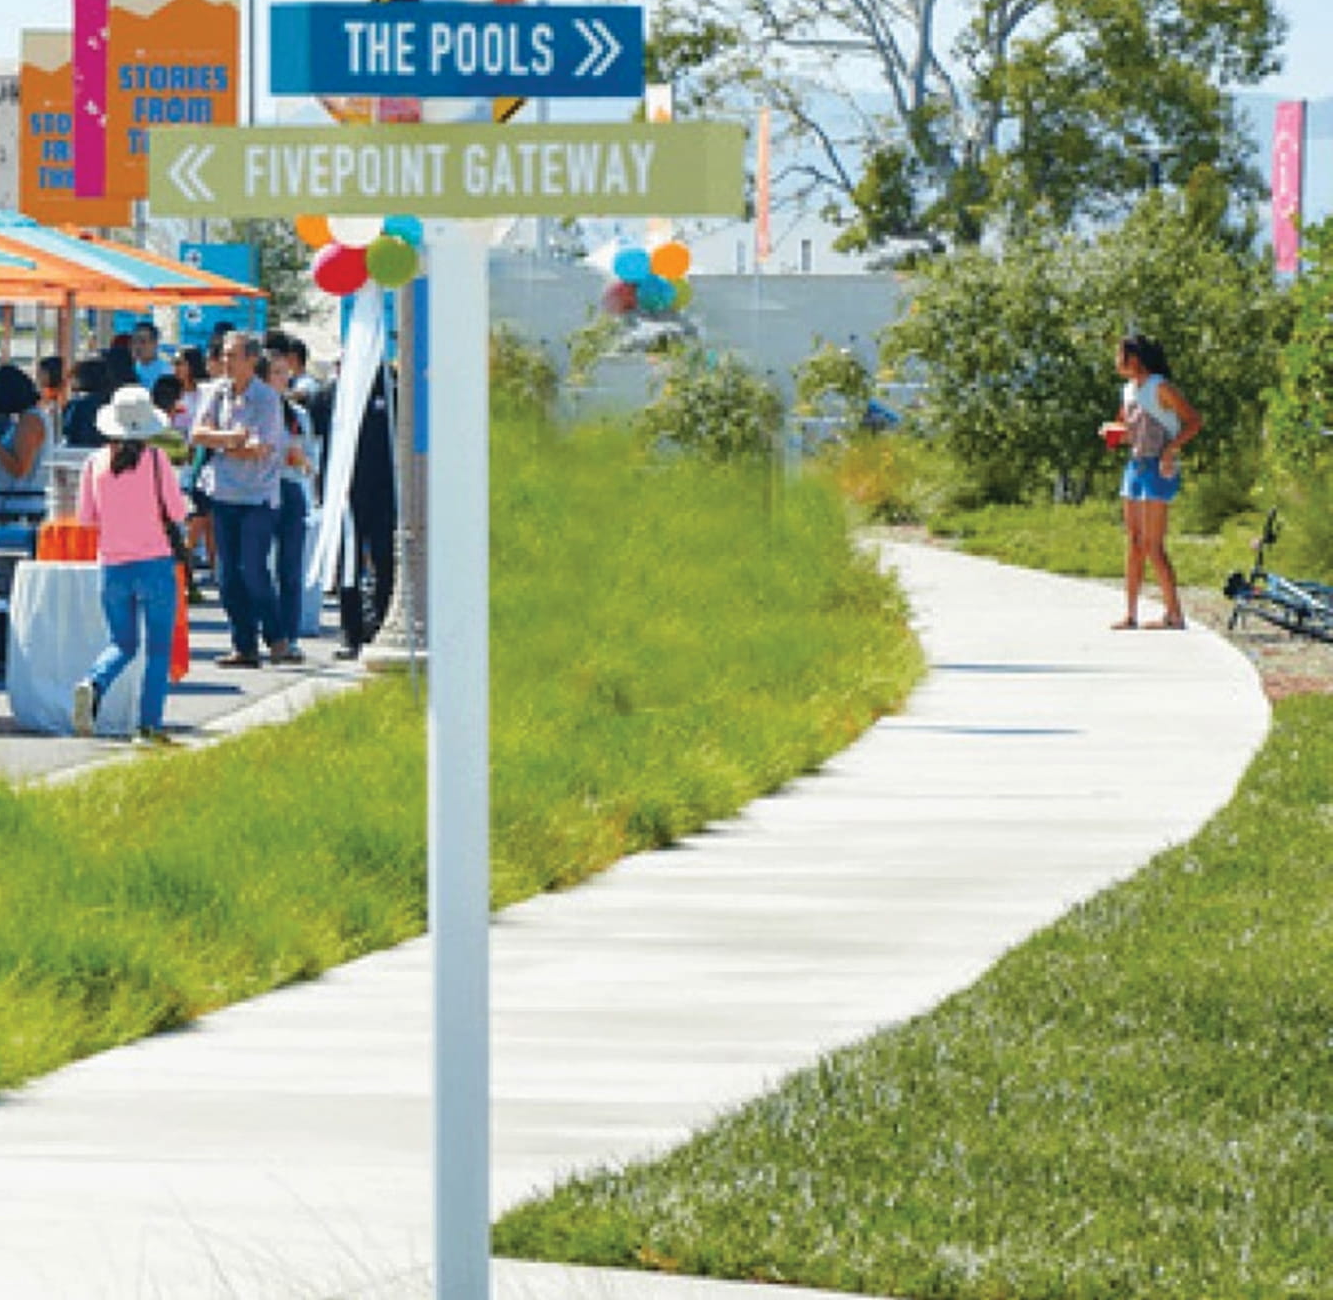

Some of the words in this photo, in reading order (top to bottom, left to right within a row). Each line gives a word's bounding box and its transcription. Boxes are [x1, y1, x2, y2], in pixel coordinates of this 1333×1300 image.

[343, 20, 416, 75] THE
[430, 21, 555, 77] POOLS
[118, 64, 229, 92] STORIES
[133, 97, 212, 124] FROM
[244, 143, 447, 198] FIVEPOINT
[461, 140, 659, 197] GATEWAY
